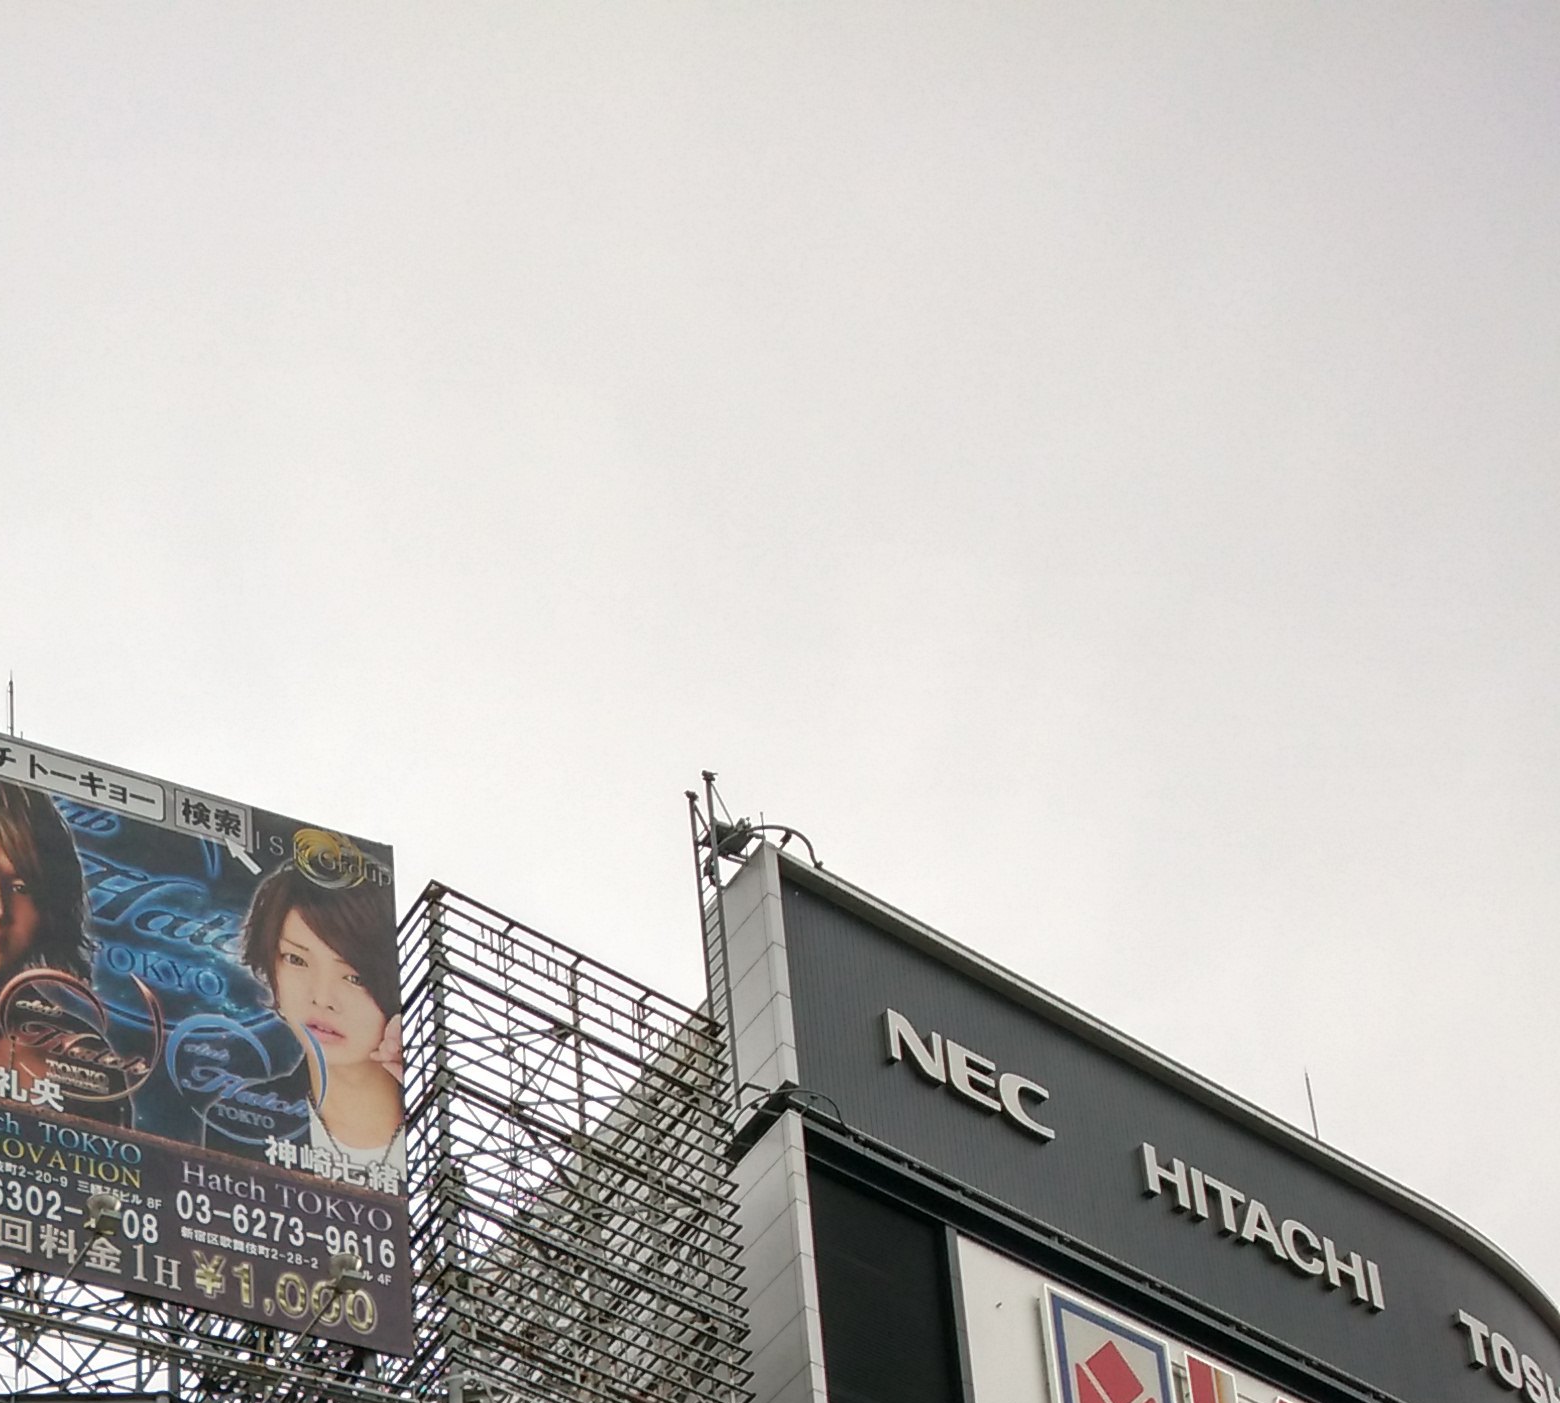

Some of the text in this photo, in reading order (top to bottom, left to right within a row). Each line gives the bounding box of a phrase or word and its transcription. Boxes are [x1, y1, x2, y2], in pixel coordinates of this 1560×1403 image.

[29, 754, 156, 805] トーキョー
[182, 797, 243, 839] 検索
[882, 1007, 1056, 1142] NEC
[38, 1121, 142, 1165] TOKYO
[216, 1104, 276, 1129] TOKYO
[176, 1189, 397, 1270] 03-6273-9616
[182, 1160, 393, 1233] Hatch TOKYO
[1140, 1141, 1387, 1312] HITACHI
